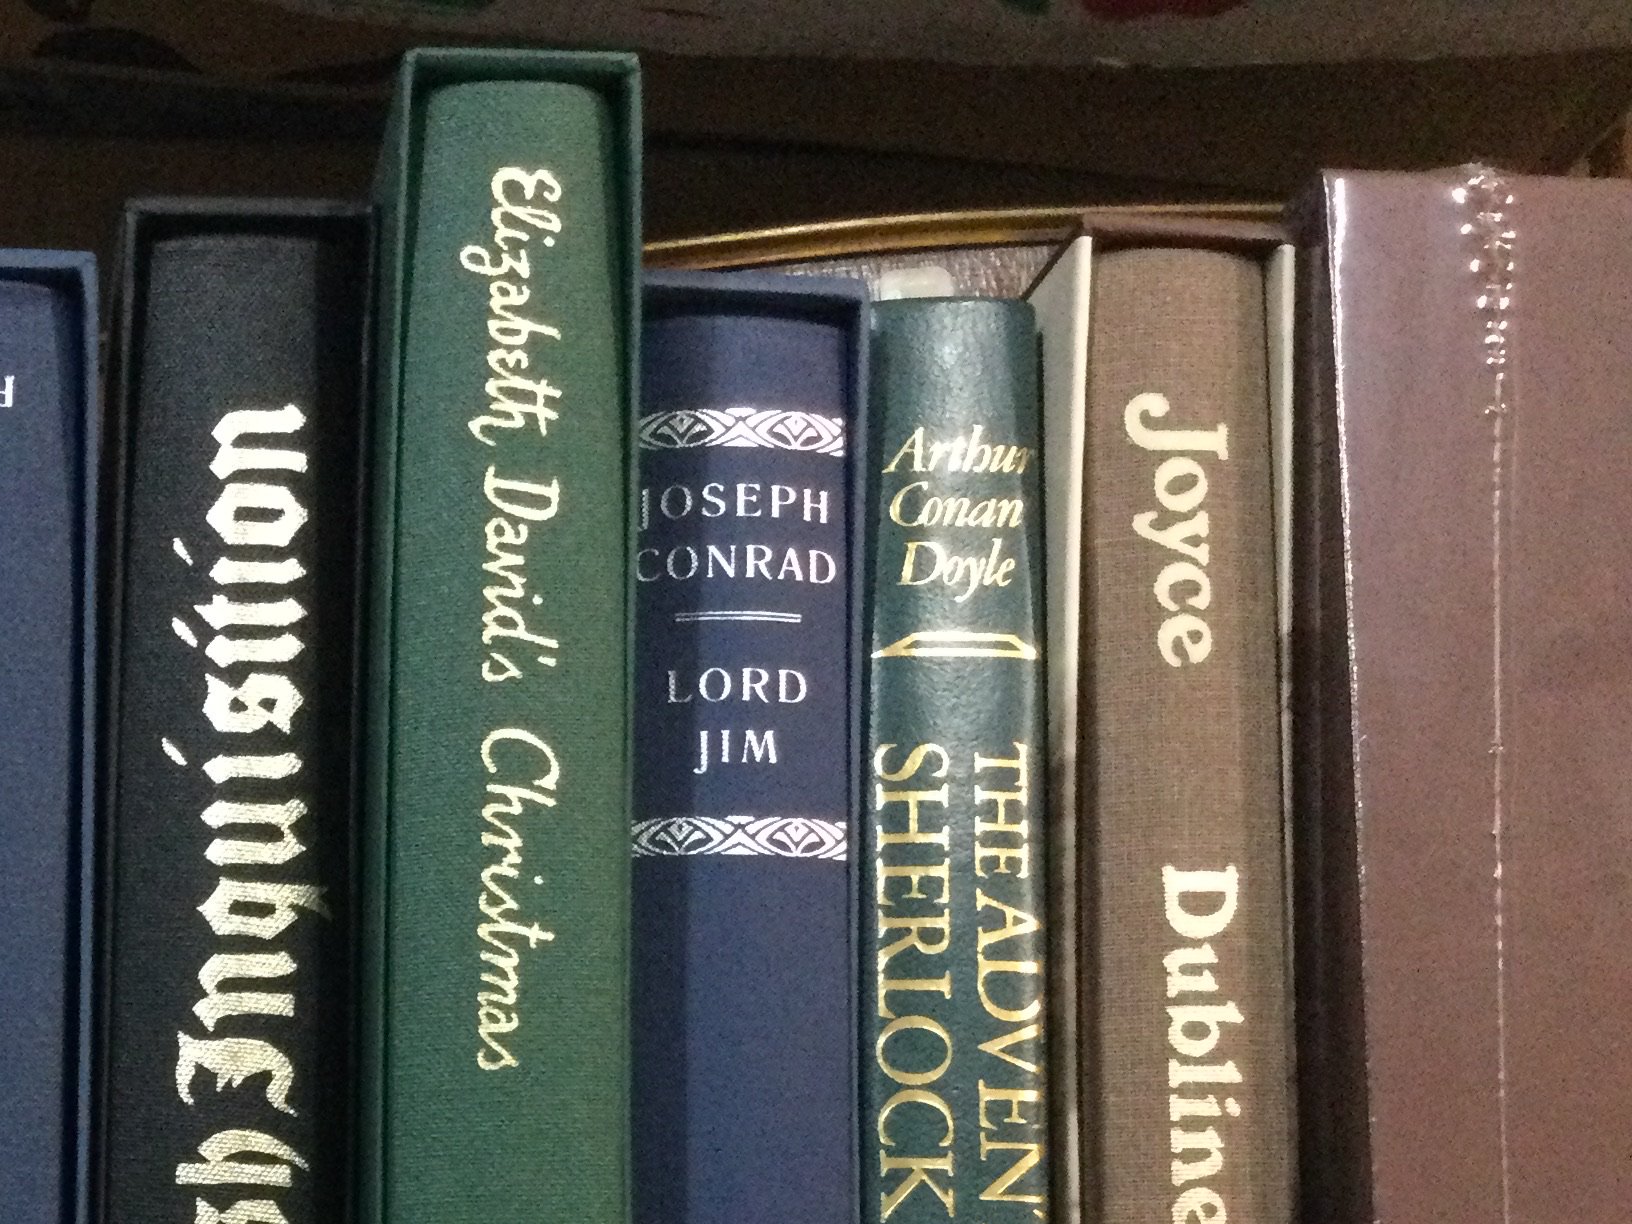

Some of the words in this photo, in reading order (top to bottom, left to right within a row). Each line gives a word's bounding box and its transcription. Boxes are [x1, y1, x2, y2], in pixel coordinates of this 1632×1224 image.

[459, 165, 563, 447] Elizabeth
[882, 425, 1032, 475] Arthur
[637, 483, 829, 531] JOSEPH
[889, 482, 1025, 527] Conan
[1124, 392, 1230, 668] Joyce
[481, 465, 561, 684] David's
[635, 544, 837, 584] CONRAD
[897, 538, 1017, 602] Doyle
[668, 667, 807, 704] LORD
[162, 404, 332, 1118] Inquisition
[693, 729, 778, 774] JIM
[974, 741, 1029, 879] THE
[477, 728, 561, 1071] Christmas
[873, 743, 956, 1222] SHERLOCK
